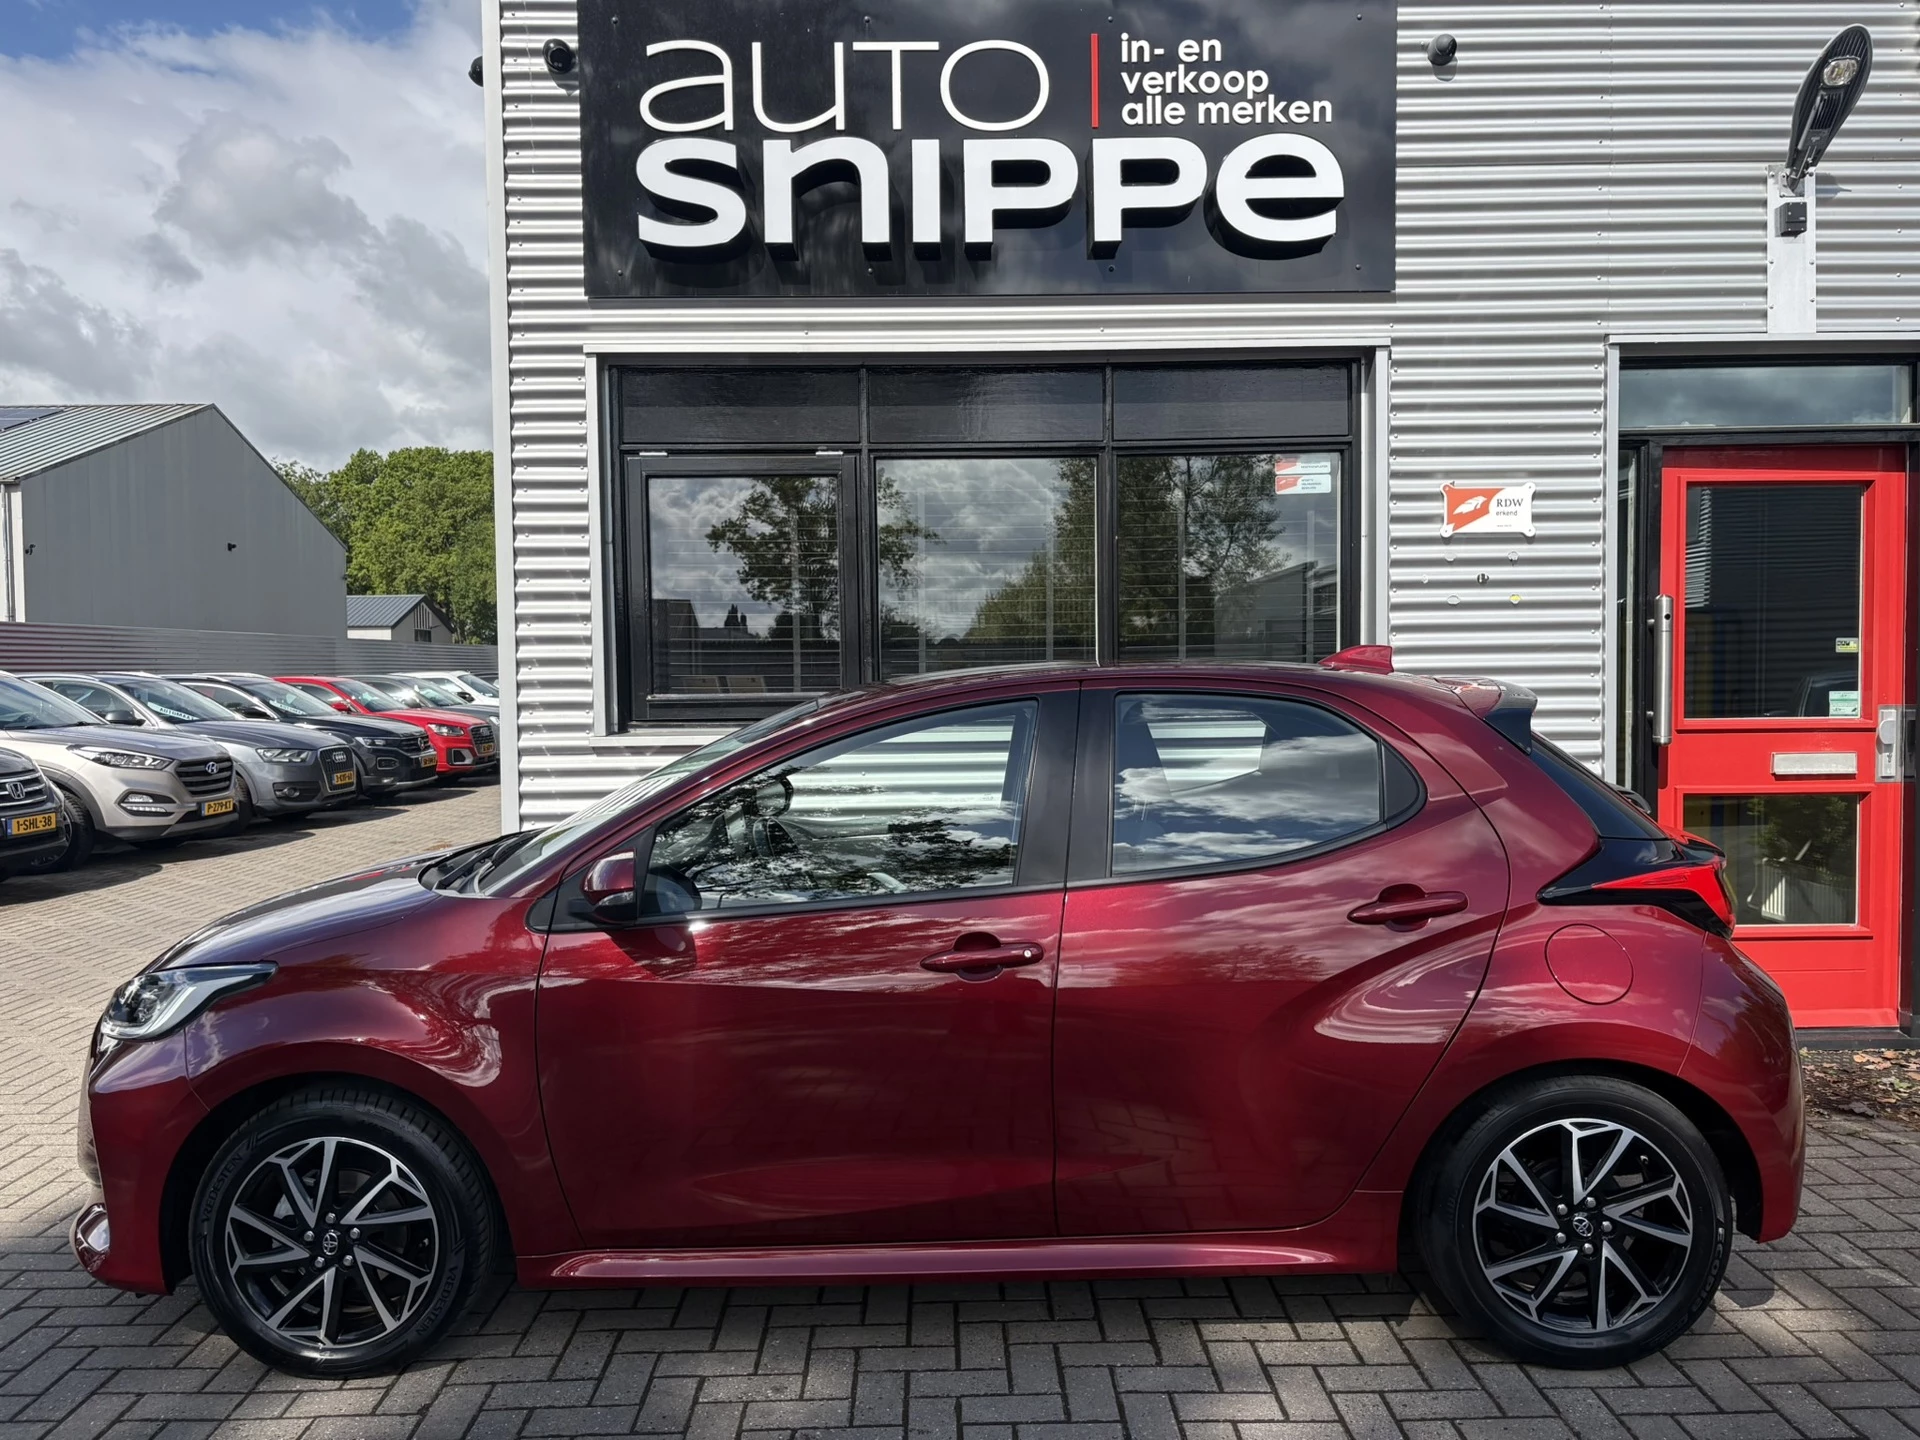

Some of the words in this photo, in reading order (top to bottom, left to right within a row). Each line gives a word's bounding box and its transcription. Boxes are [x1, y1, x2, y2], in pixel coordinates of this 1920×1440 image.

[1120, 32, 1165, 63] in-
[1178, 38, 1222, 62] en
[1120, 64, 1269, 99] verkoop
[1121, 95, 1186, 125] alle
[1198, 94, 1333, 124] merken
[1496, 498, 1523, 508] RDW
[16, 815, 52, 832] 1-SHL-38
[201, 1152, 242, 1223] VREDESTEIN
[416, 1265, 459, 1336] VREDESTEIN
